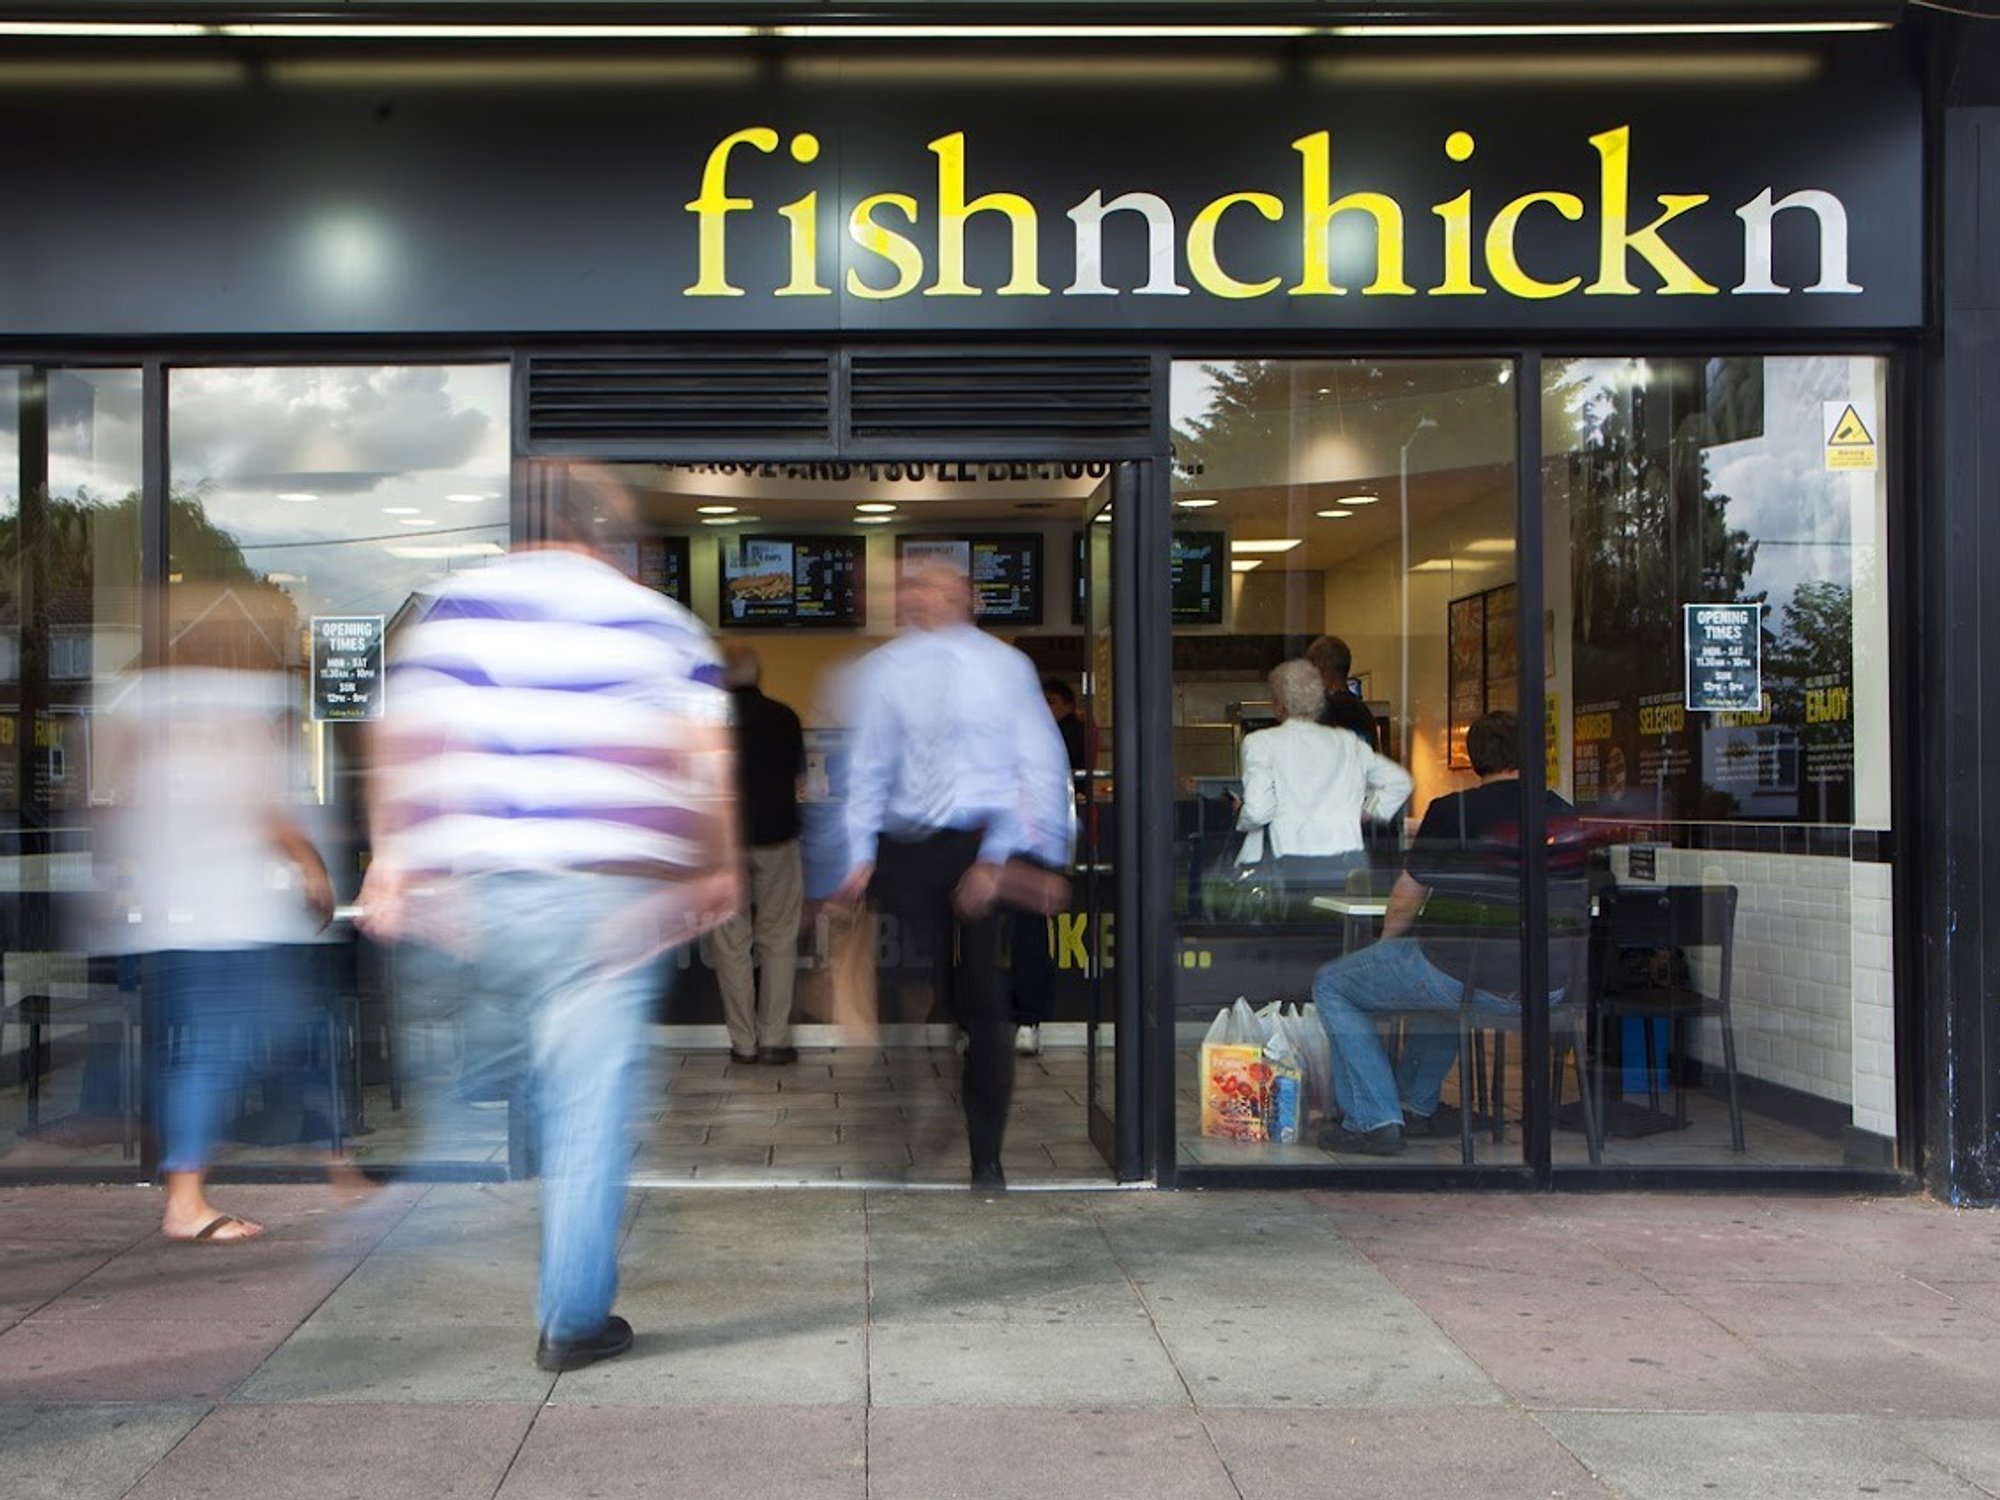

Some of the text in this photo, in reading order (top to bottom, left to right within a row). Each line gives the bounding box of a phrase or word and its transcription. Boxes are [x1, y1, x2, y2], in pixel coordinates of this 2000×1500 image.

[684, 125, 1864, 298] fishnchickn
[1697, 610, 1748, 625] OPENING
[322, 622, 373, 637] OPENING
[1704, 626, 1742, 639] TIMES
[330, 638, 366, 651] TIMES
[1806, 687, 1849, 724] ENJOY
[1639, 703, 1685, 735] SELECTED
